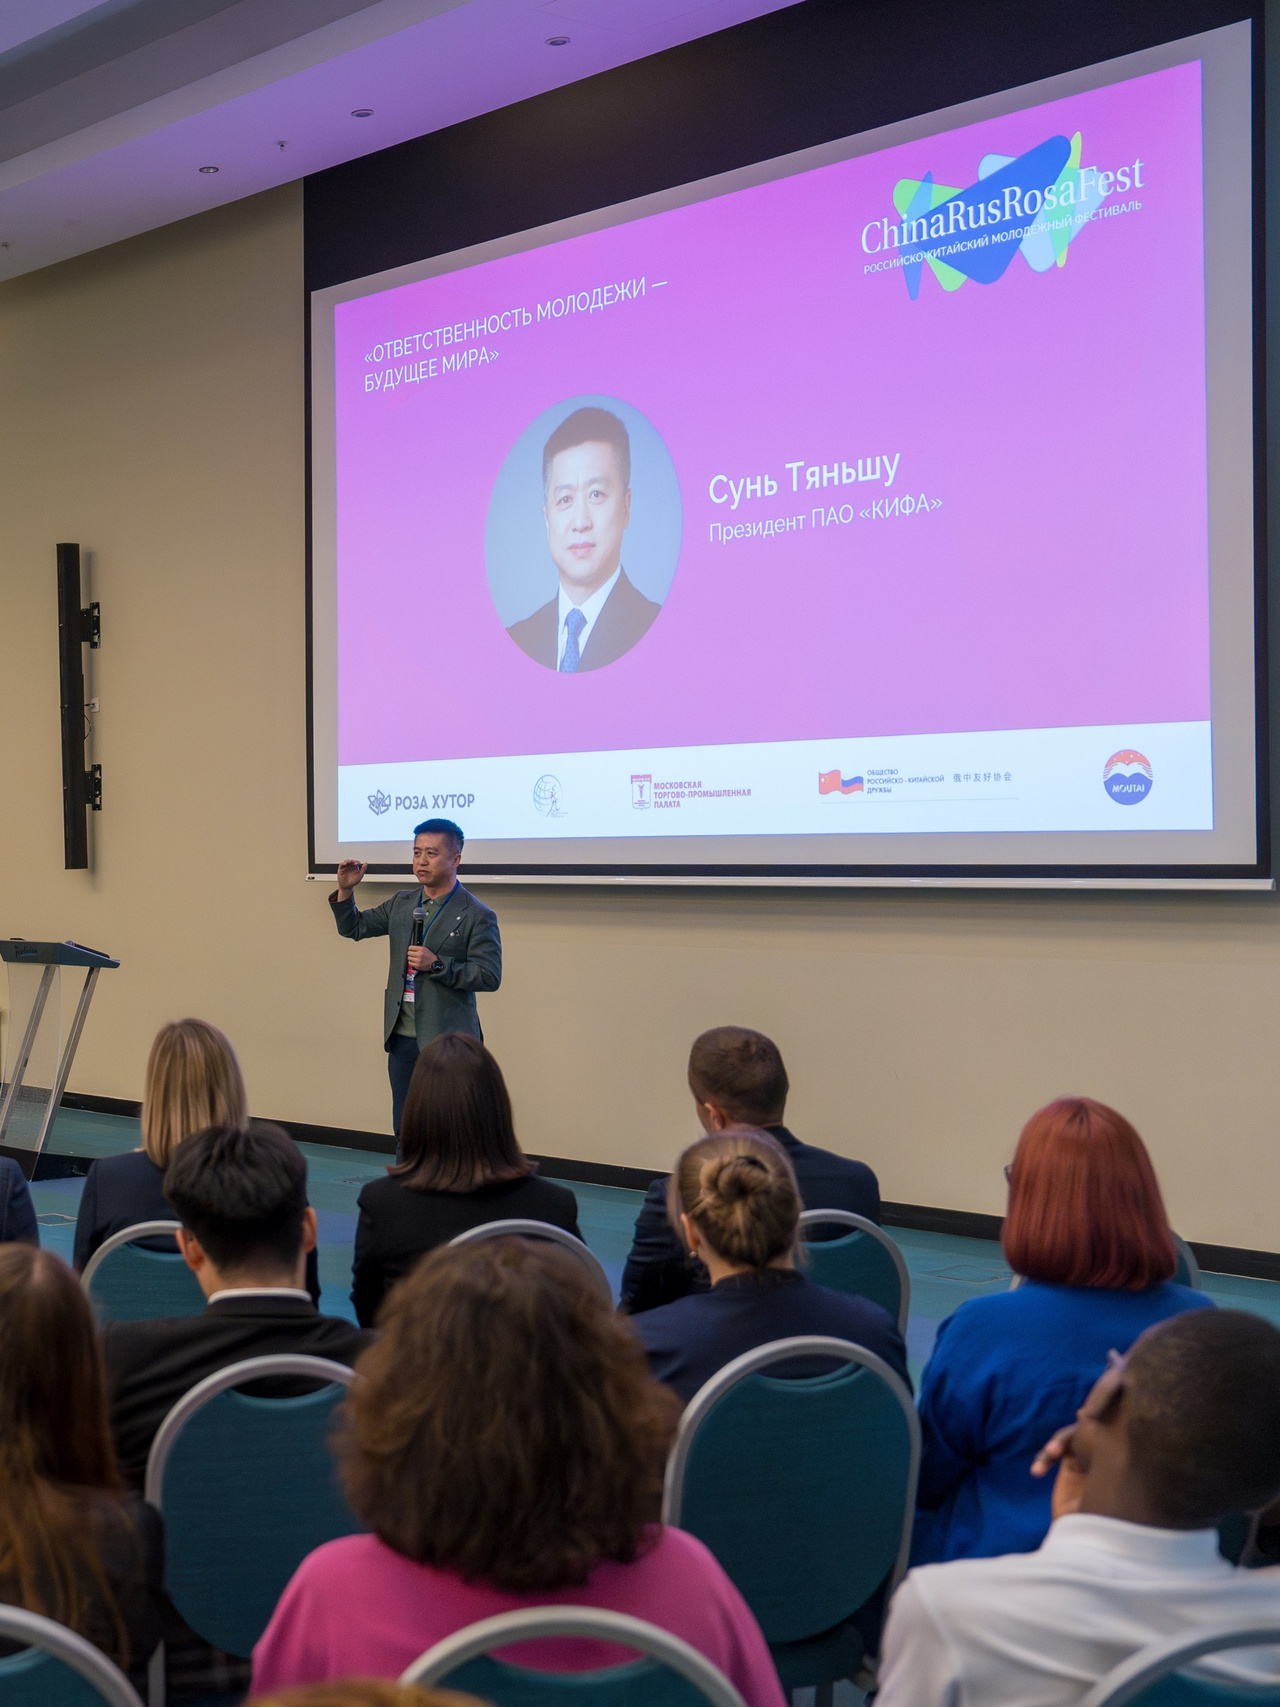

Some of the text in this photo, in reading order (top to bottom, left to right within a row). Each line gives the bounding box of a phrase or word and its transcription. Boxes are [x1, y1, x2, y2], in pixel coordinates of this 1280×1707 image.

[860, 158, 1145, 255] ChinaRusRosaFest
[863, 200, 1143, 275] РОССИЙСКО-КИТАЙСКИЙ МОЛОДЕЖНЫЙ ФЕСТИВАЛЬ
[363, 307, 532, 364] «ОТВЕТСТВЕННОСТЬ
[536, 276, 646, 322] МОЛОДЕЖИ
[364, 346, 499, 393] БУДУЩЕЕ МИРА»
[708, 452, 901, 510] Сунь Тяньшу
[709, 492, 943, 546] Президент ПАО «КИФА»
[866, 768, 899, 776] ОБЩЕСТВО
[653, 780, 702, 790] МОСКОВСКАЯ
[653, 788, 752, 800] ТОРГОВО-ПРОМЫШЛЕННАЯ
[866, 786, 892, 795] ДРУЖБЫ
[1111, 784, 1146, 793] MOUTAI
[395, 793, 475, 811] РОЗА ХУТОР
[653, 800, 682, 809] ПАЛАТА
